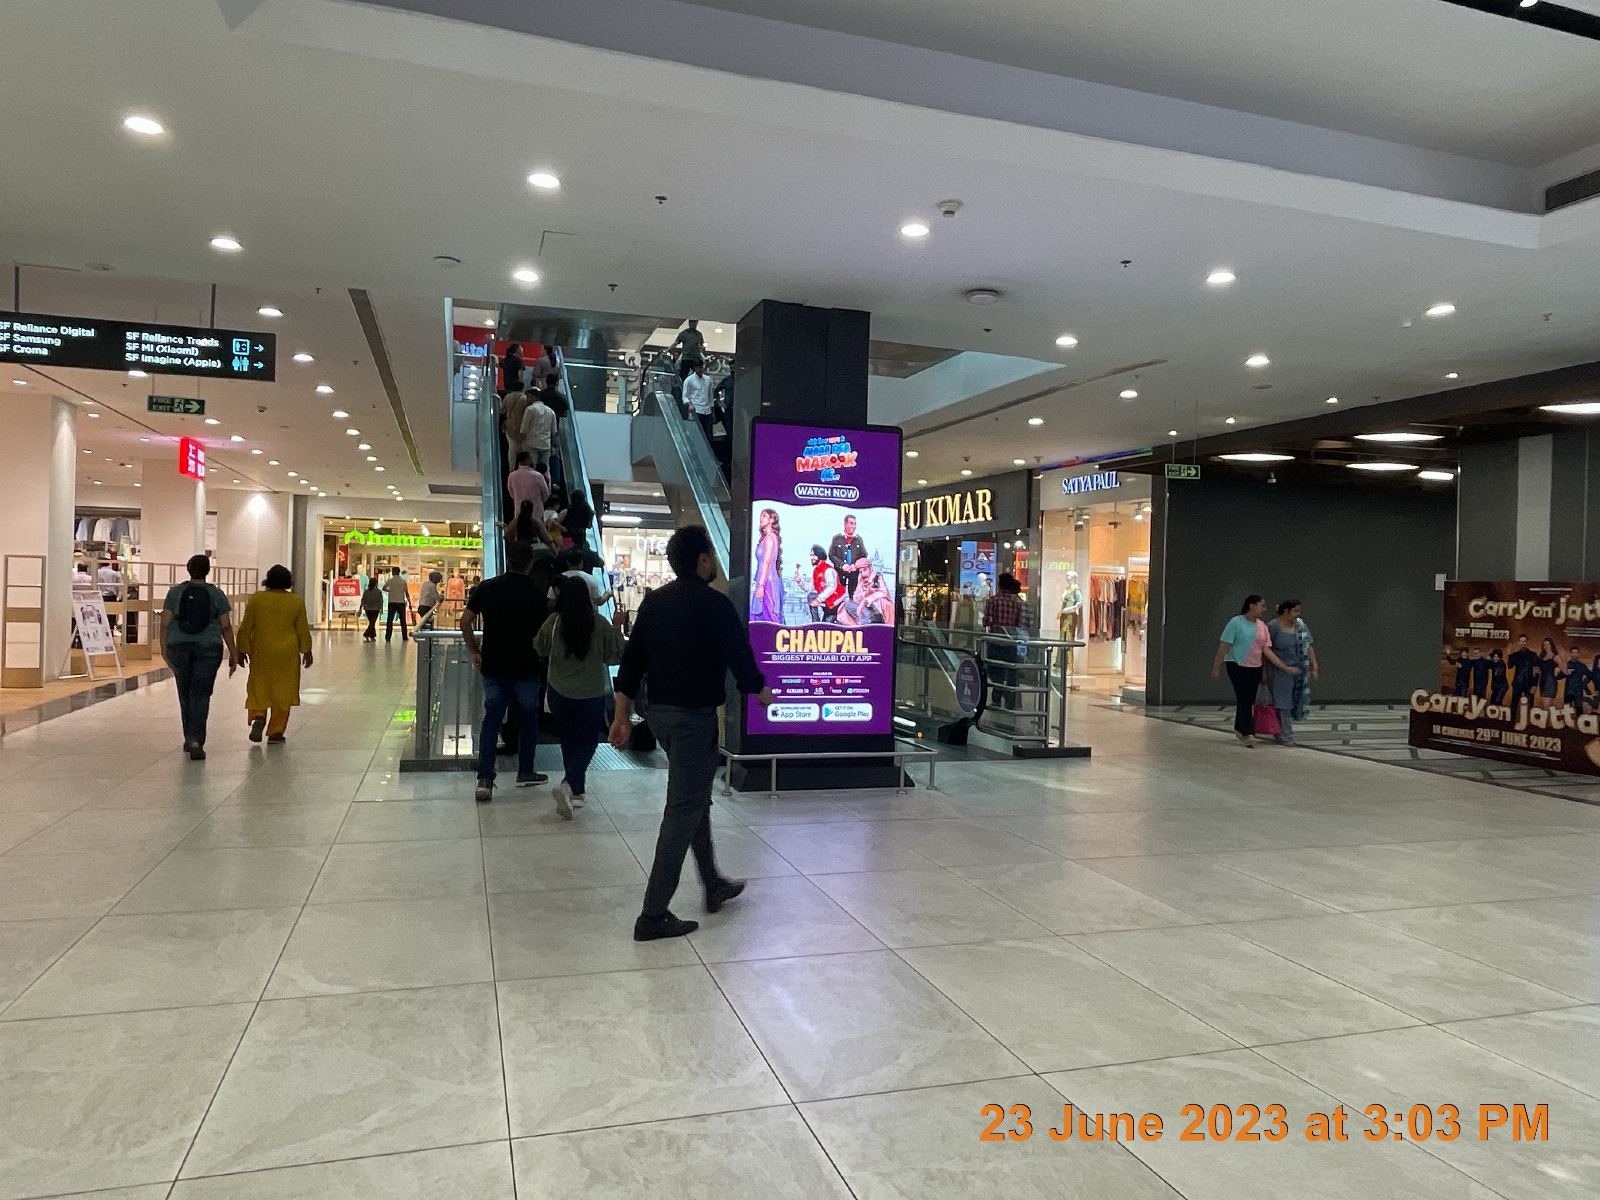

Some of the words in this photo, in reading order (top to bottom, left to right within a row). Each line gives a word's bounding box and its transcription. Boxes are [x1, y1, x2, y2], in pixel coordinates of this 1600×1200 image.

[13, 323, 58, 334] Reliance
[60, 326, 95, 337] Digital
[13, 334, 61, 346] Samsung
[126, 331, 139, 340] SF
[141, 332, 183, 344] Reliance
[186, 336, 219, 347] Trends
[13, 345, 48, 355] Croma
[126, 342, 139, 351] SF
[155, 345, 199, 356] (Xiaomi)
[125, 353, 139, 361] SF
[141, 354, 181, 365] Imagine
[183, 357, 221, 368] (Apple)
[797, 486, 831, 497] WATCH
[832, 488, 857, 498] NOW
[925, 489, 992, 527] KUMAR
[338, 585, 356, 594] sale
[1468, 597, 1533, 620] Carry
[1532, 604, 1553, 618] on
[776, 629, 868, 653] CHAUPAL
[1490, 630, 1510, 640] 2023
[1411, 688, 1487, 720] Carry
[1486, 704, 1512, 721] on
[1514, 695, 1600, 735] jatta
[1502, 731, 1528, 747] JUNE
[1530, 735, 1562, 753] 2023
